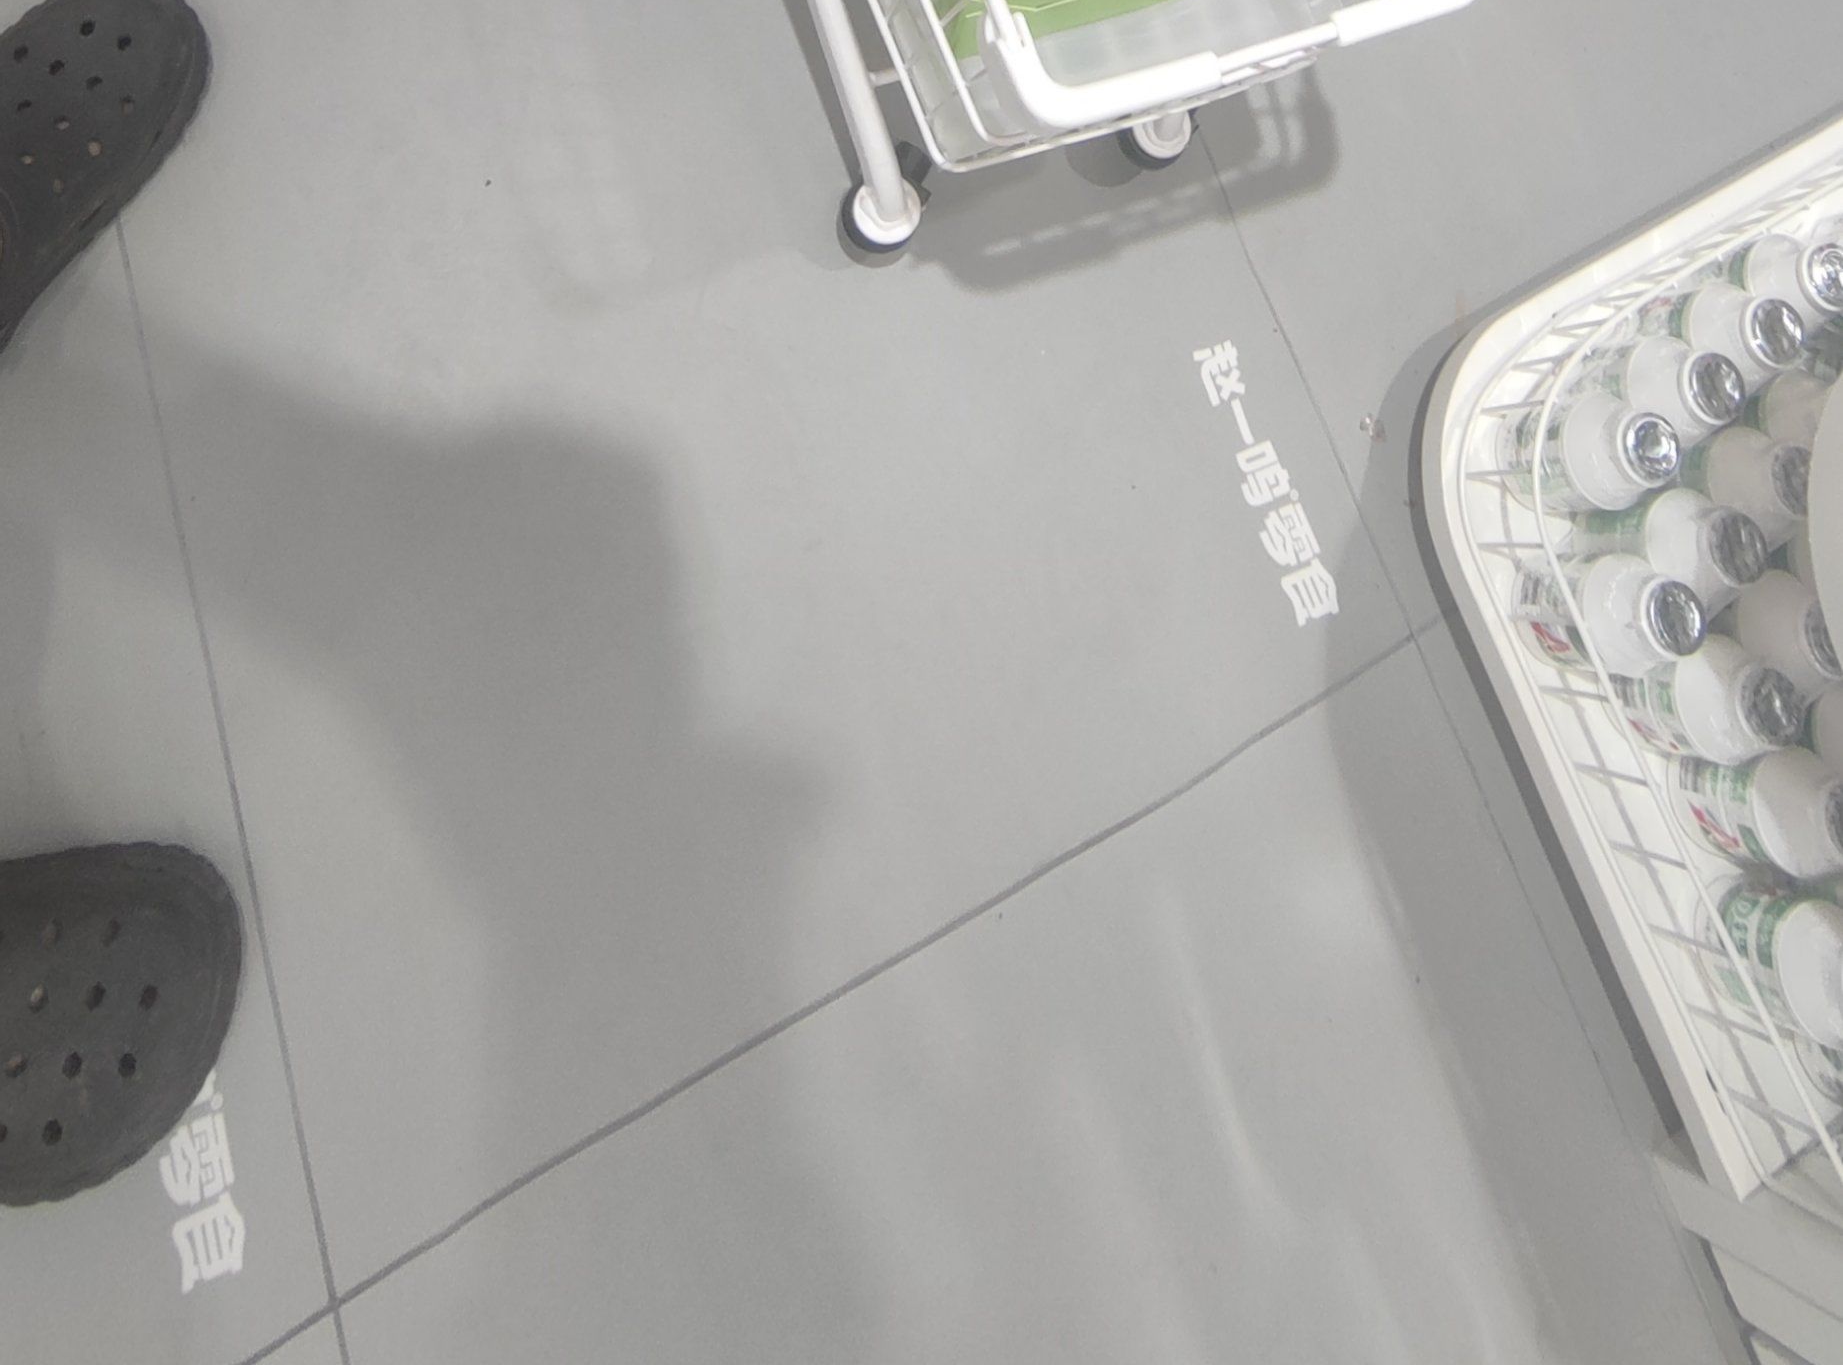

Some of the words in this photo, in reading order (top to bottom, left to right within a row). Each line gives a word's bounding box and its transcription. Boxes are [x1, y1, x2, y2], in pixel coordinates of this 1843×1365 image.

[1193, 339, 1340, 626] 赵一鸣零食
[160, 1070, 246, 1295] 零食
